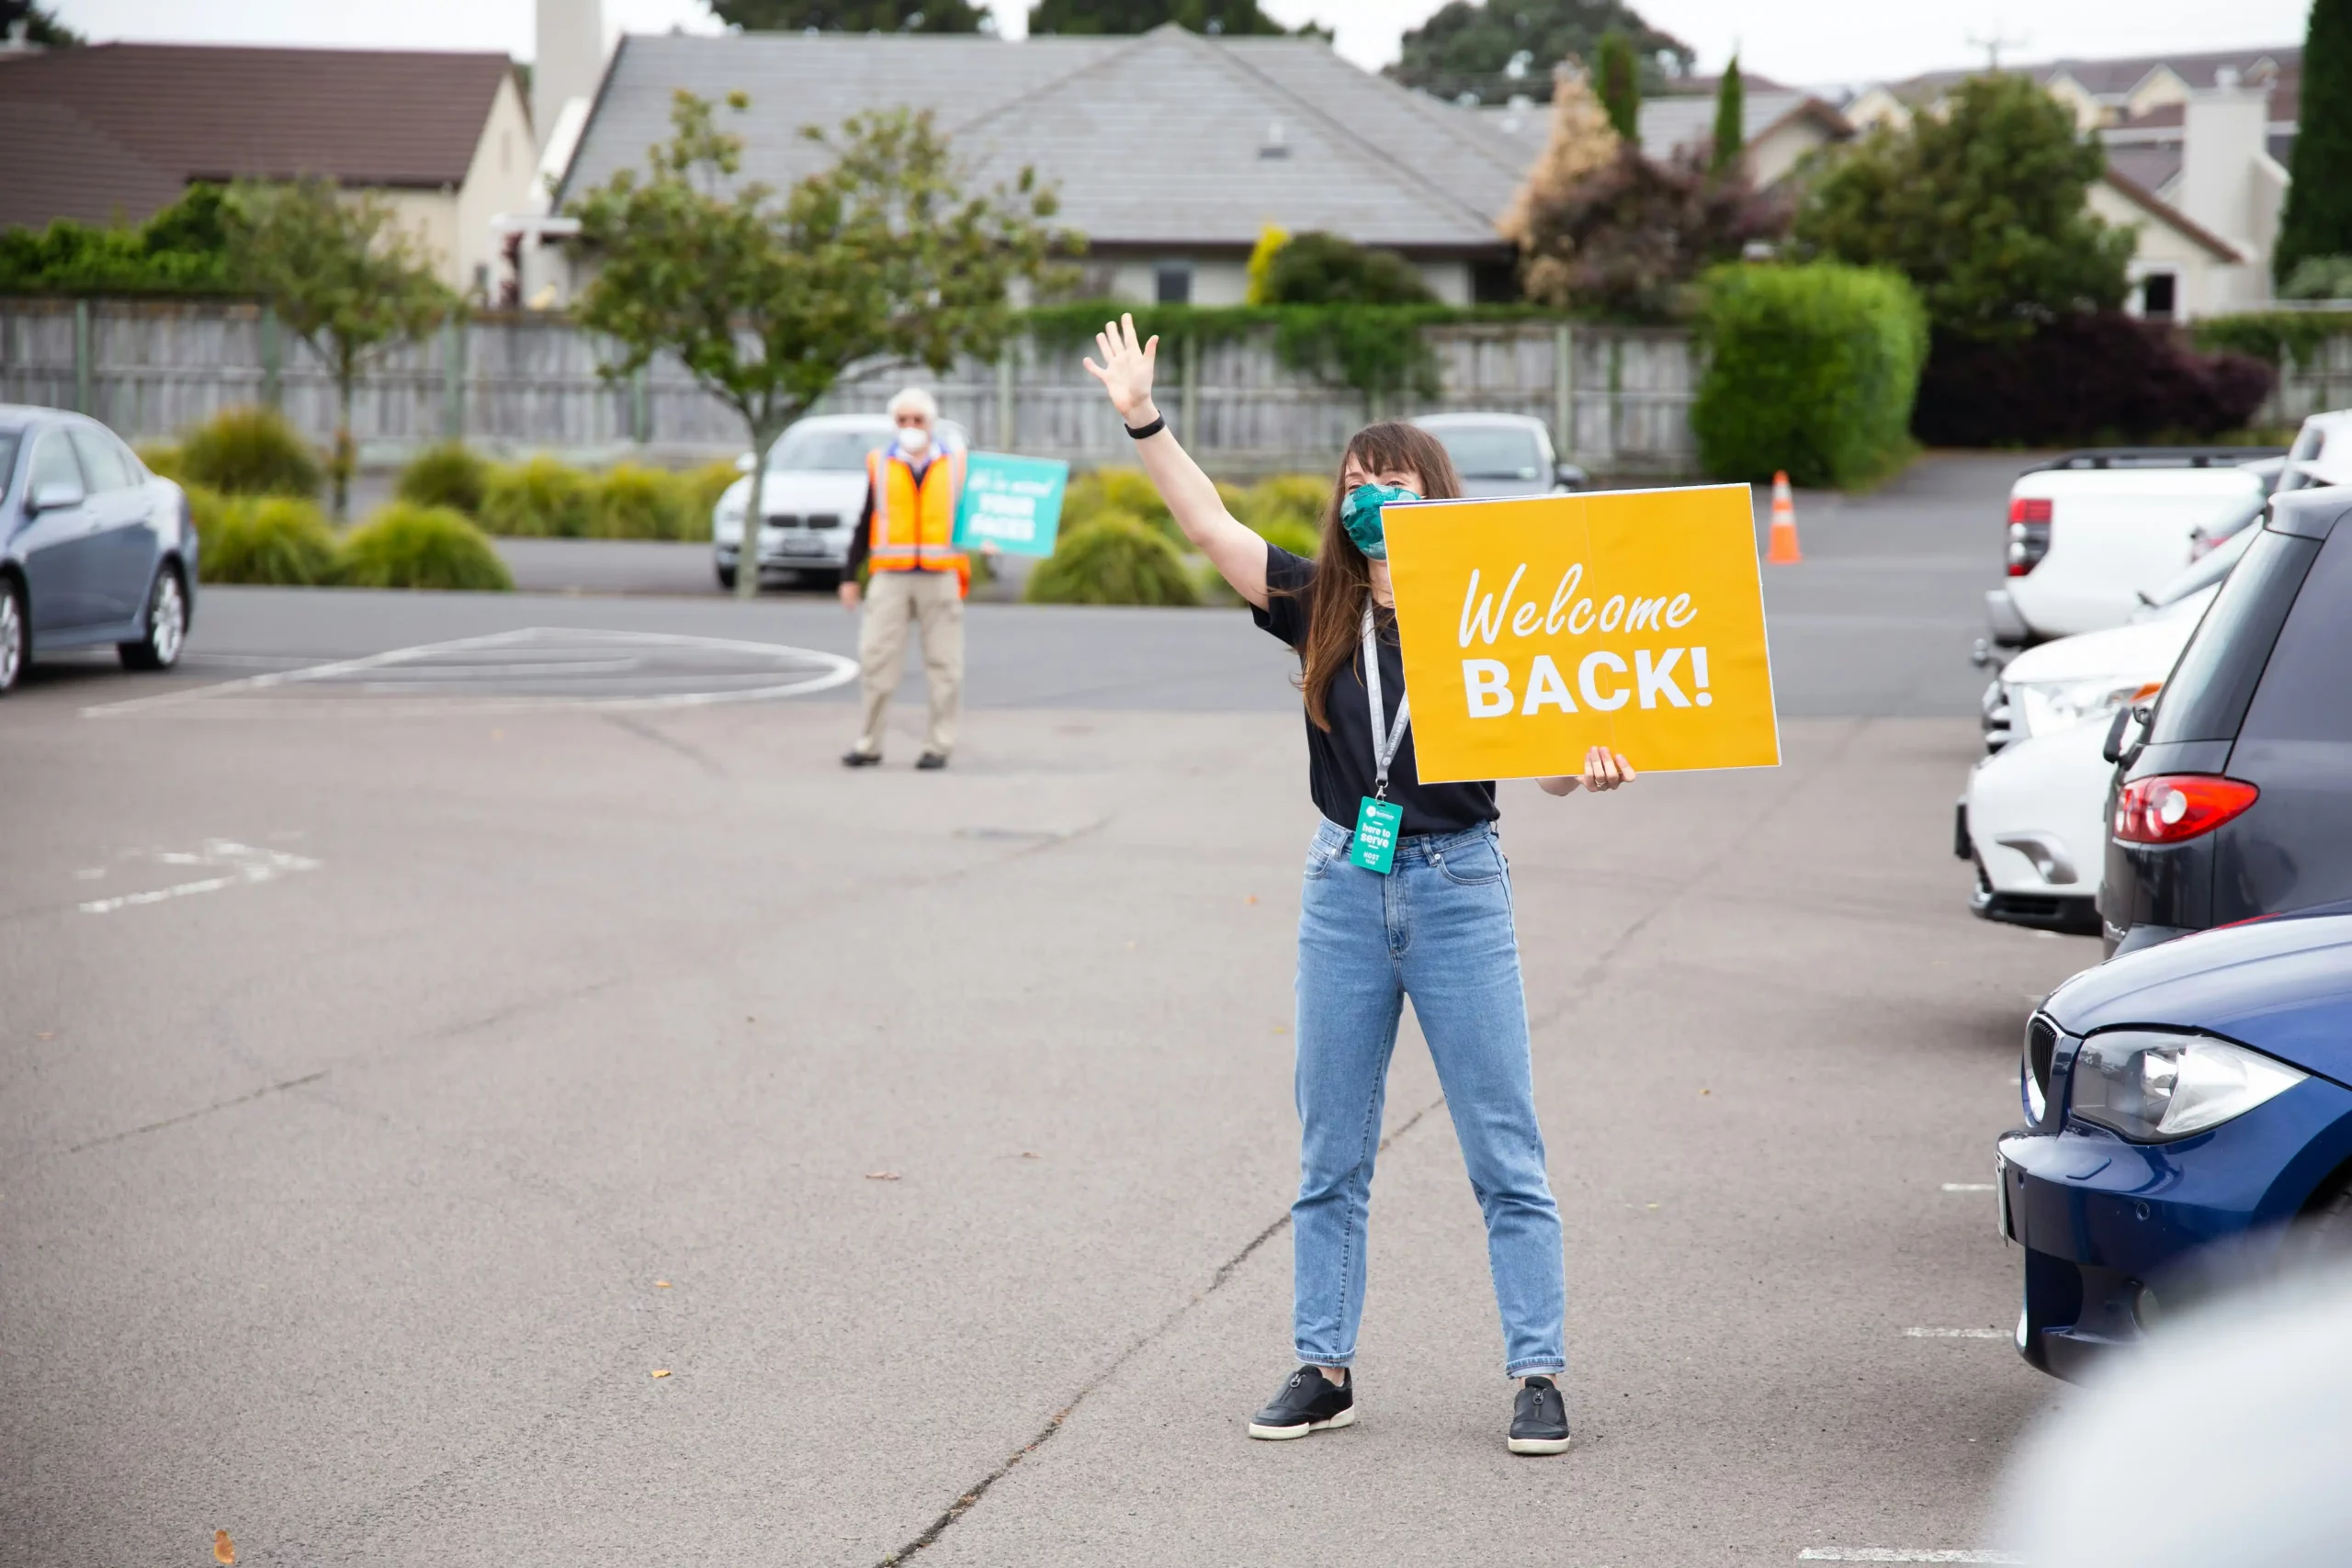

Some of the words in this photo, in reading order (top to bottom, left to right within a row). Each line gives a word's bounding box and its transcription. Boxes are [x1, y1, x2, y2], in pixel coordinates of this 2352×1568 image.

[1459, 562, 1698, 649] Welcome
[1462, 647, 1713, 718] BACK!
[1363, 822, 1381, 835] here
[1382, 829, 1391, 838] to
[1361, 833, 1389, 848] serve
[1363, 852, 1380, 861] HOST
